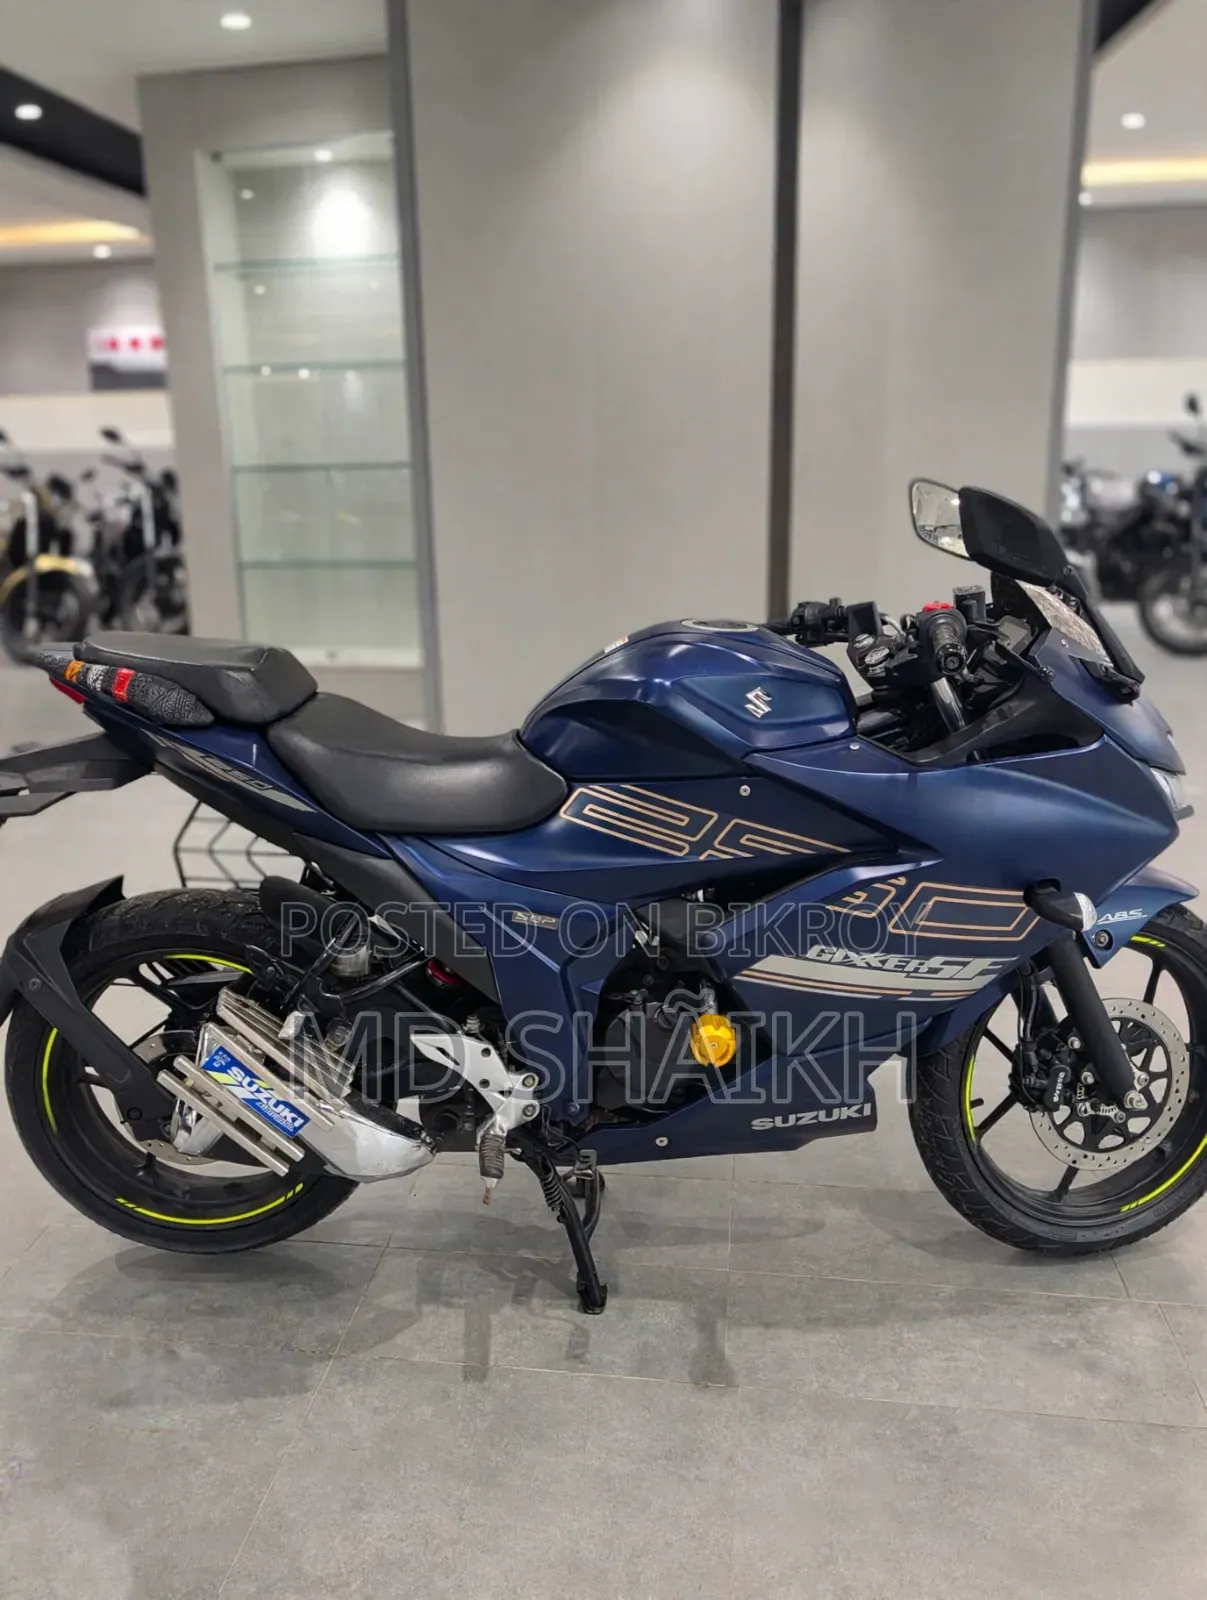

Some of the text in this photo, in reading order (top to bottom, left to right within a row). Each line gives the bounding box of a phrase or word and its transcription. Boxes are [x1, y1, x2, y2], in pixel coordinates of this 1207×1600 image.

[1096, 908, 1147, 926] ABS
[226, 1066, 305, 1128] SUZUKI
[750, 1102, 873, 1131] SUZUKI
